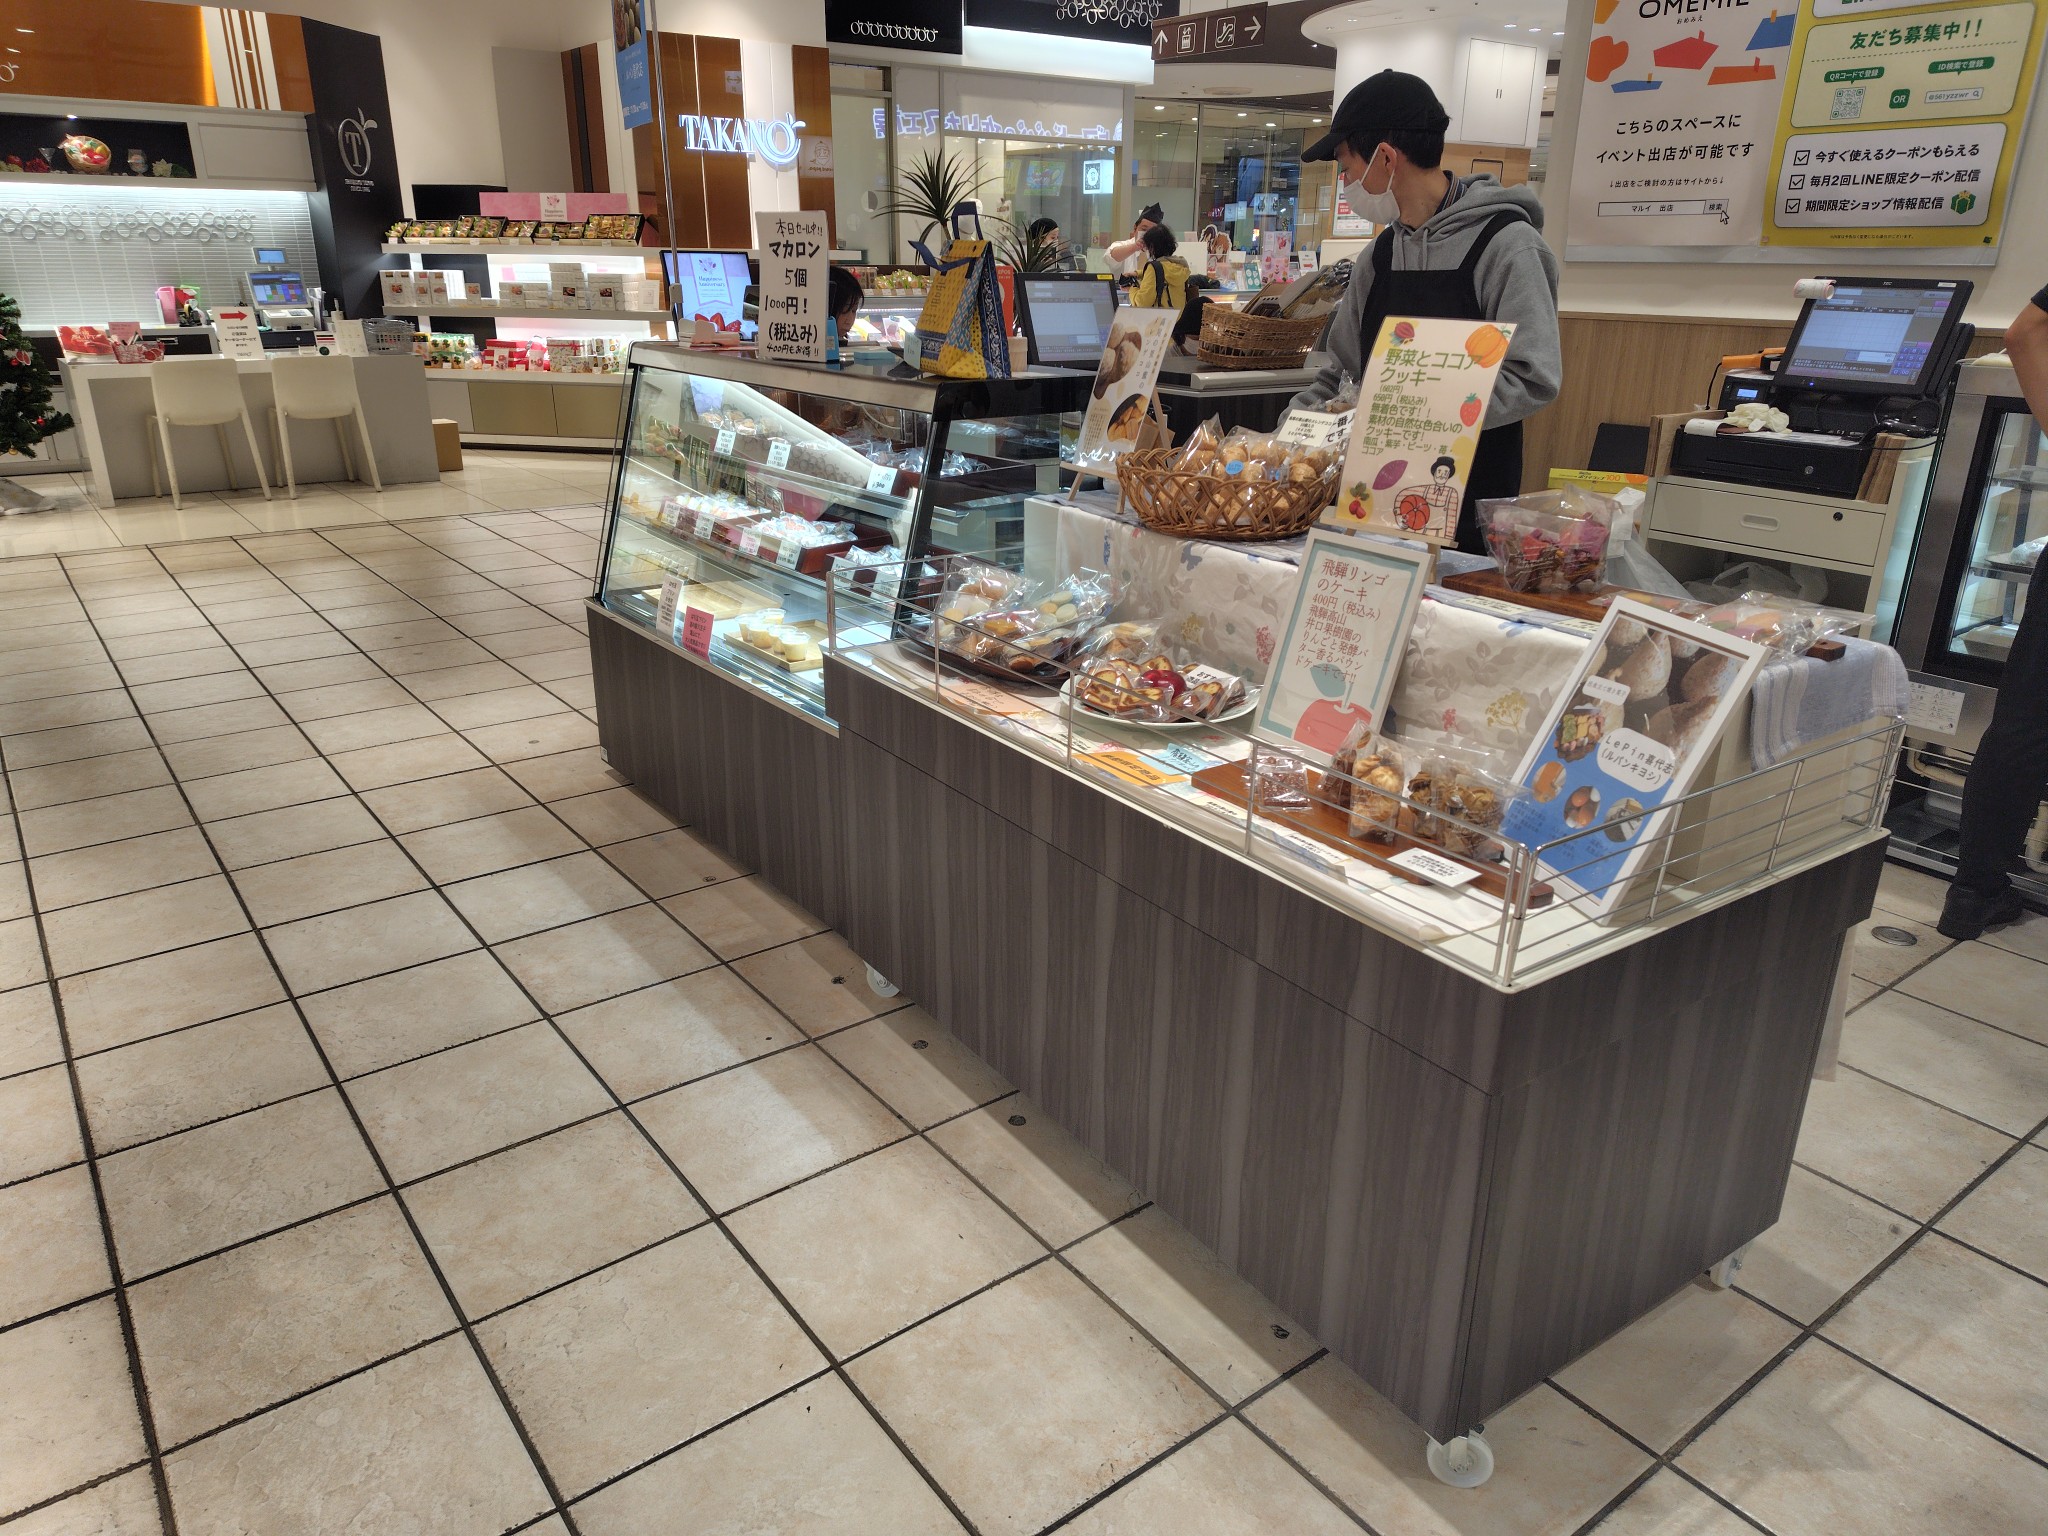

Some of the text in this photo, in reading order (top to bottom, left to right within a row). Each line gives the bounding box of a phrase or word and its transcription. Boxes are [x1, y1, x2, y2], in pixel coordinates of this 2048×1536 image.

[1677, 15, 1704, 25] おめみえ
[1829, 68, 1879, 81] QRコードで登録
[1937, 60, 1984, 71] ID検索で登録
[1892, 95, 1906, 104] OR
[1616, 114, 1742, 135] こちらのスペースに
[679, 112, 804, 164] TAKANO
[1596, 142, 1755, 164] イベント出店が可能です
[1815, 143, 1980, 164] 今すぐ使えるクーポンもらえる
[1810, 169, 1982, 188] 毎月2回LINE限定クーポン配信
[1631, 204, 1674, 213] マルイ 出店
[1708, 203, 1722, 211] 検索
[1804, 196, 1945, 212] 期間限定ショップ情報配信
[768, 240, 821, 259] マカロン
[784, 268, 807, 288] 5個
[1383, 348, 1483, 371] 野菜とココア
[1380, 368, 1442, 387] クッキー
[1367, 415, 1463, 434] 素材の自然な色合いの
[1326, 428, 1346, 442] です
[1361, 446, 1385, 456] ココア
[1321, 558, 1390, 587] 飛騨リンゴ
[1317, 578, 1369, 602] のケーキ
[1309, 606, 1347, 625] 飛騨高山
[1304, 617, 1362, 643] 井口果樹園の
[1302, 631, 1369, 658] りんごと発酵バ
[1297, 644, 1365, 671] ター香るバウン
